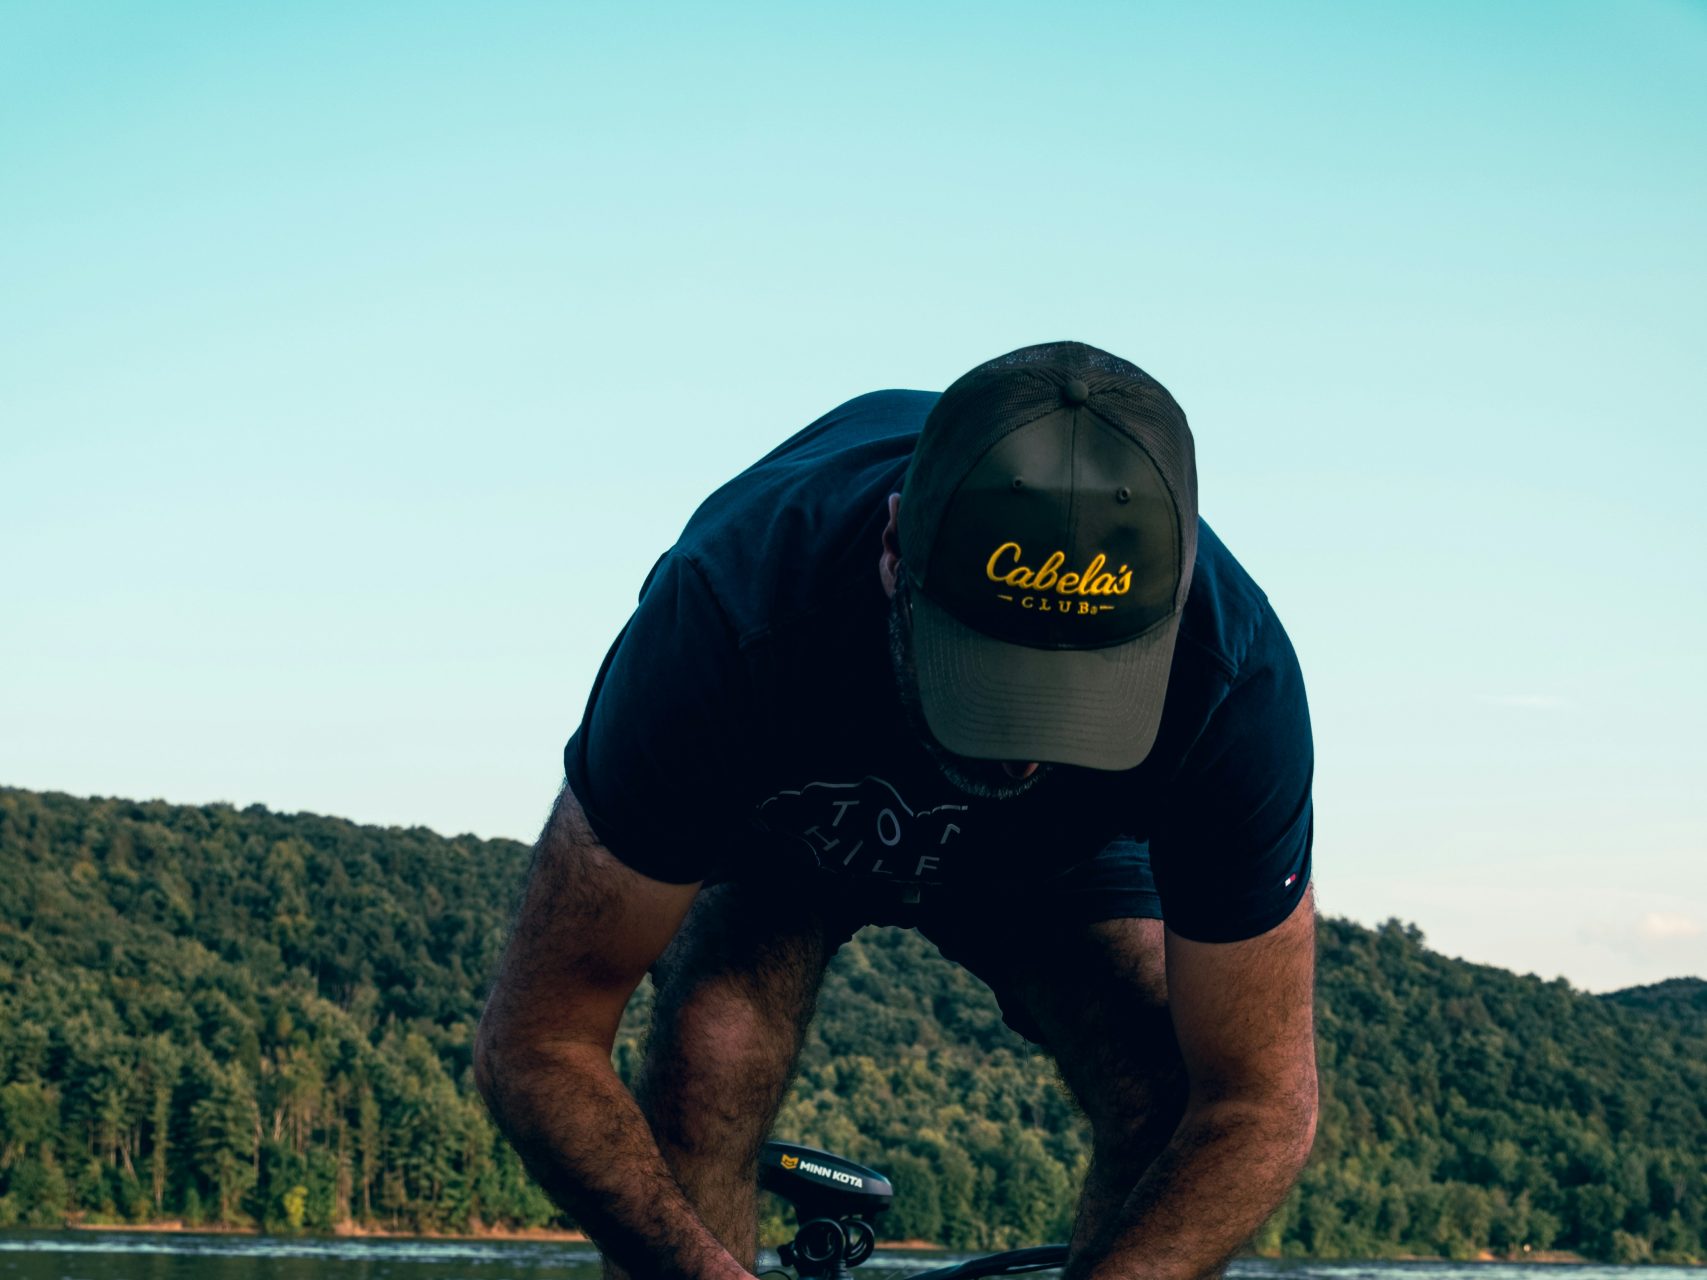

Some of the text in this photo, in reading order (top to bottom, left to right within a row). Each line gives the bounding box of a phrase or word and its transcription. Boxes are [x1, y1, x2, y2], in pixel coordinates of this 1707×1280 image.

[986, 541, 1134, 596] Cabela's
[799, 1160, 863, 1189] MINN KOTA
